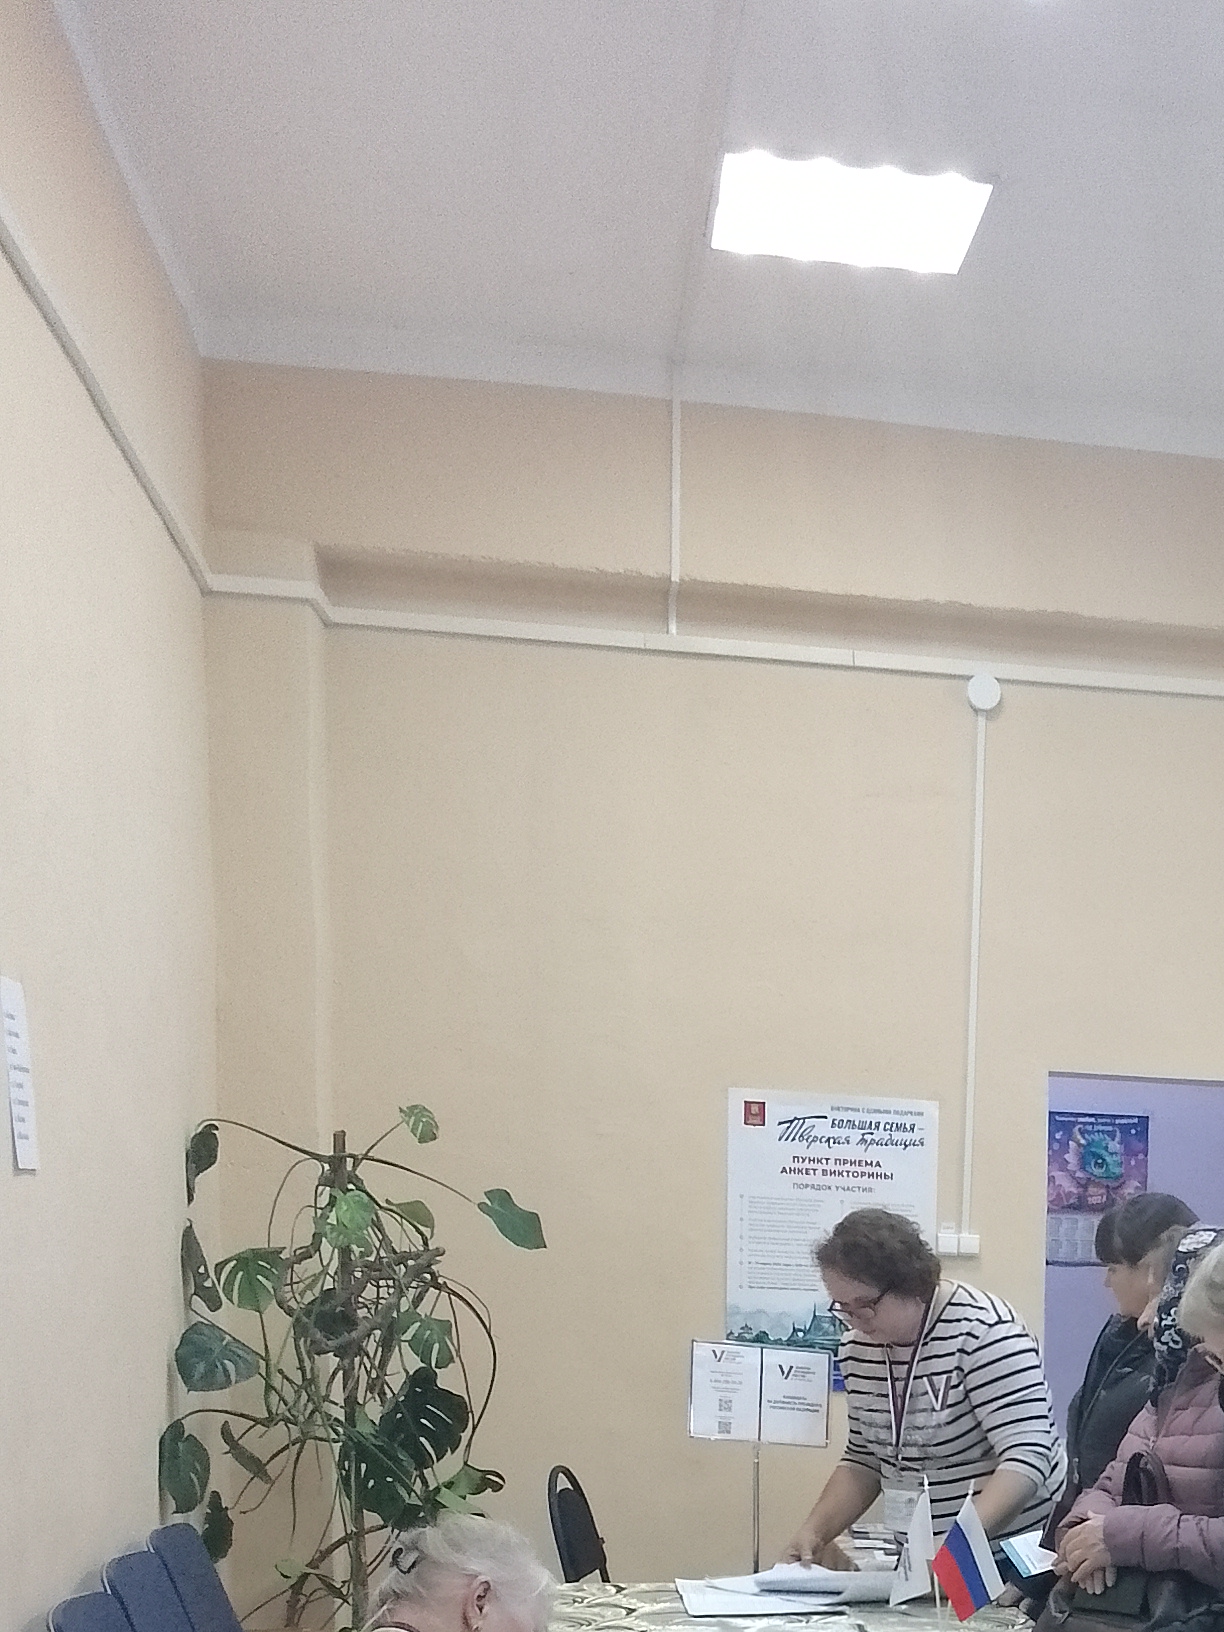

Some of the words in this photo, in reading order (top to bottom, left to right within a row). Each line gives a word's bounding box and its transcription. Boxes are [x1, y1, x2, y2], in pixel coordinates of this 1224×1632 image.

[777, 1115, 851, 1150] Тверская
[830, 1118, 881, 1132] БОЛЬШАЯ
[883, 1121, 916, 1134] СЕМЬЯ
[792, 1155, 831, 1166] ПУНКТ
[834, 1158, 882, 1169] ПРИЕМА
[780, 1166, 819, 1177] АНКЕТ
[821, 1169, 894, 1181] ВИКТОРИНЫ
[793, 1182, 832, 1192] ПОРЯДОК
